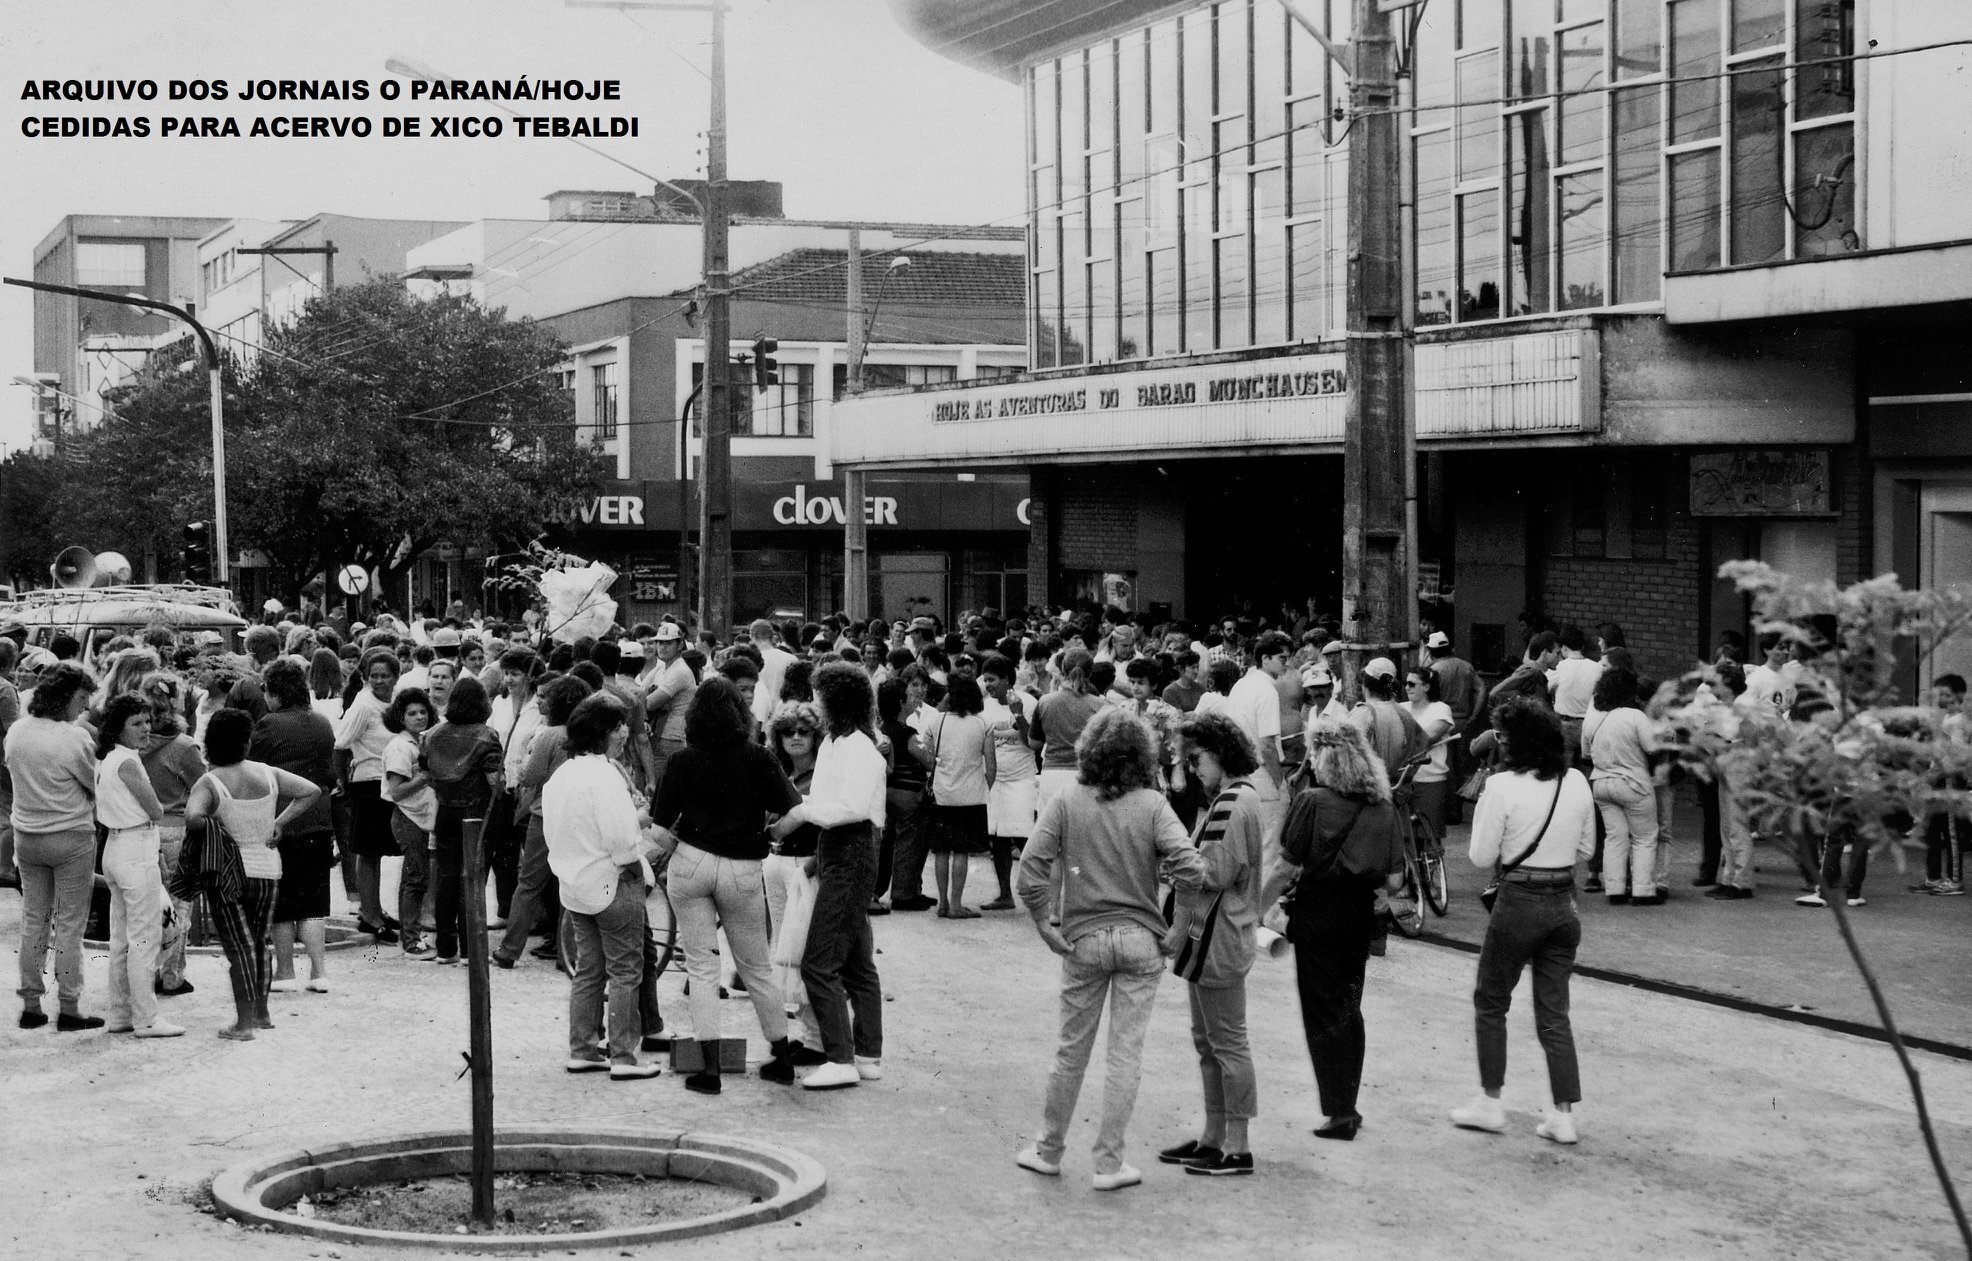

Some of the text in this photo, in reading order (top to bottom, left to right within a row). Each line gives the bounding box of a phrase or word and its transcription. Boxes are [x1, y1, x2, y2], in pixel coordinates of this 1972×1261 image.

[935, 400, 970, 422] HOJE
[974, 399, 992, 419] AS
[998, 389, 1086, 418] AVENTURAS
[1099, 388, 1119, 410] DO
[1137, 381, 1196, 407] BARAO
[635, 581, 676, 600] IBM
